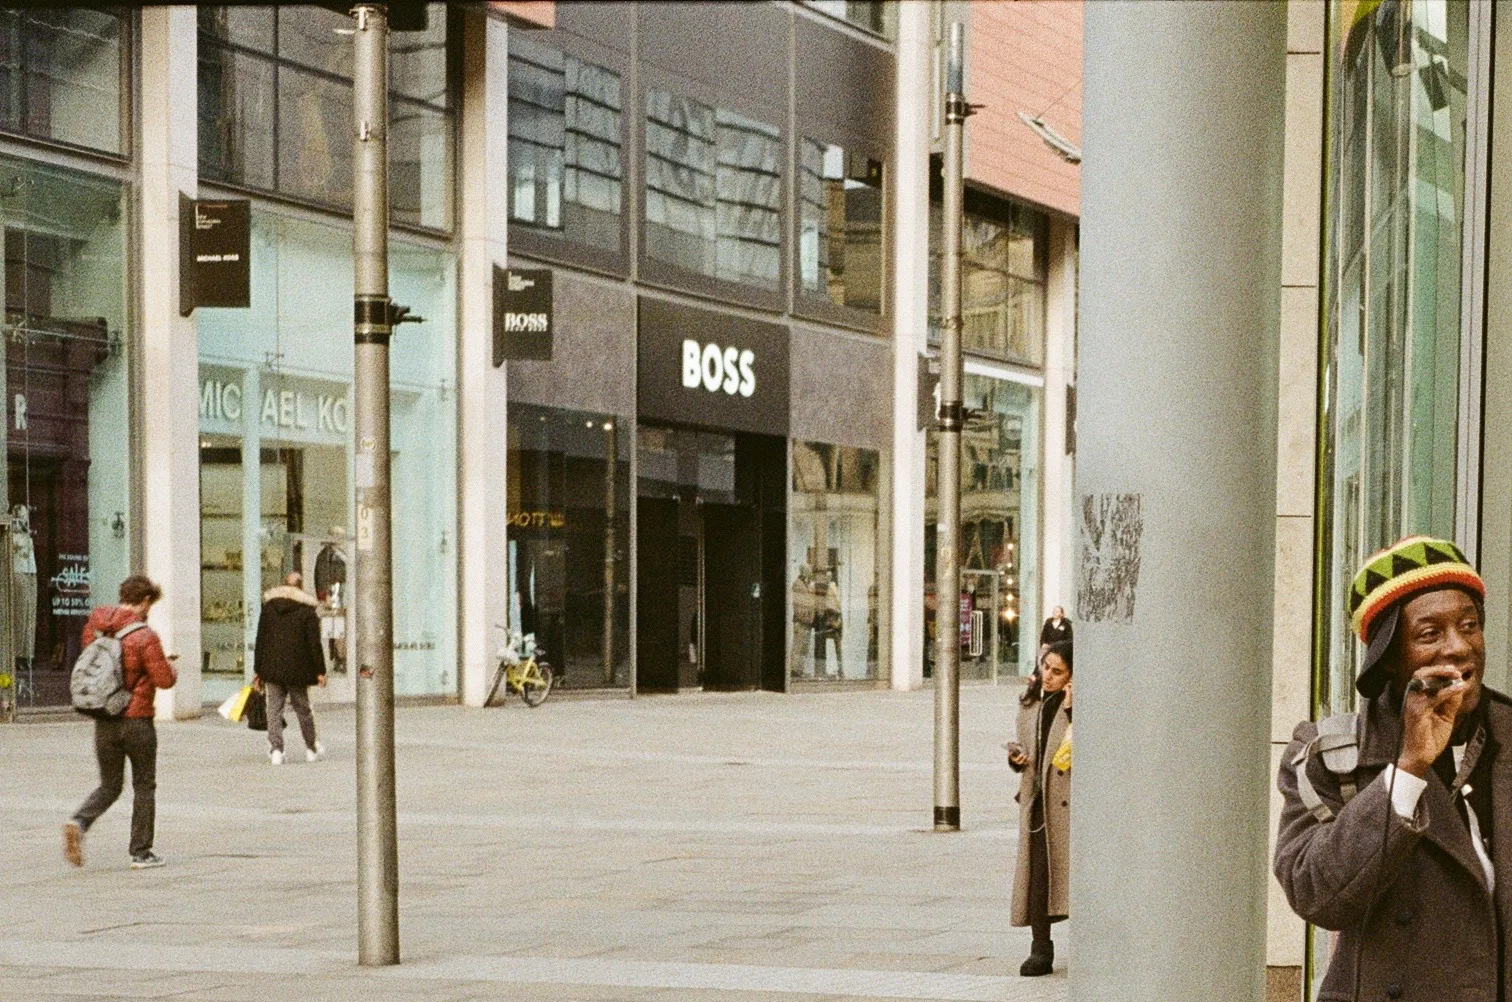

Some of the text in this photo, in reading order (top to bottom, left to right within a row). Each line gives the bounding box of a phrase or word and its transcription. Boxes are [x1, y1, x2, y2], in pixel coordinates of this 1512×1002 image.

[505, 313, 548, 328] BOSS
[682, 339, 756, 397] BOSS
[200, 380, 307, 430] MICAEL
